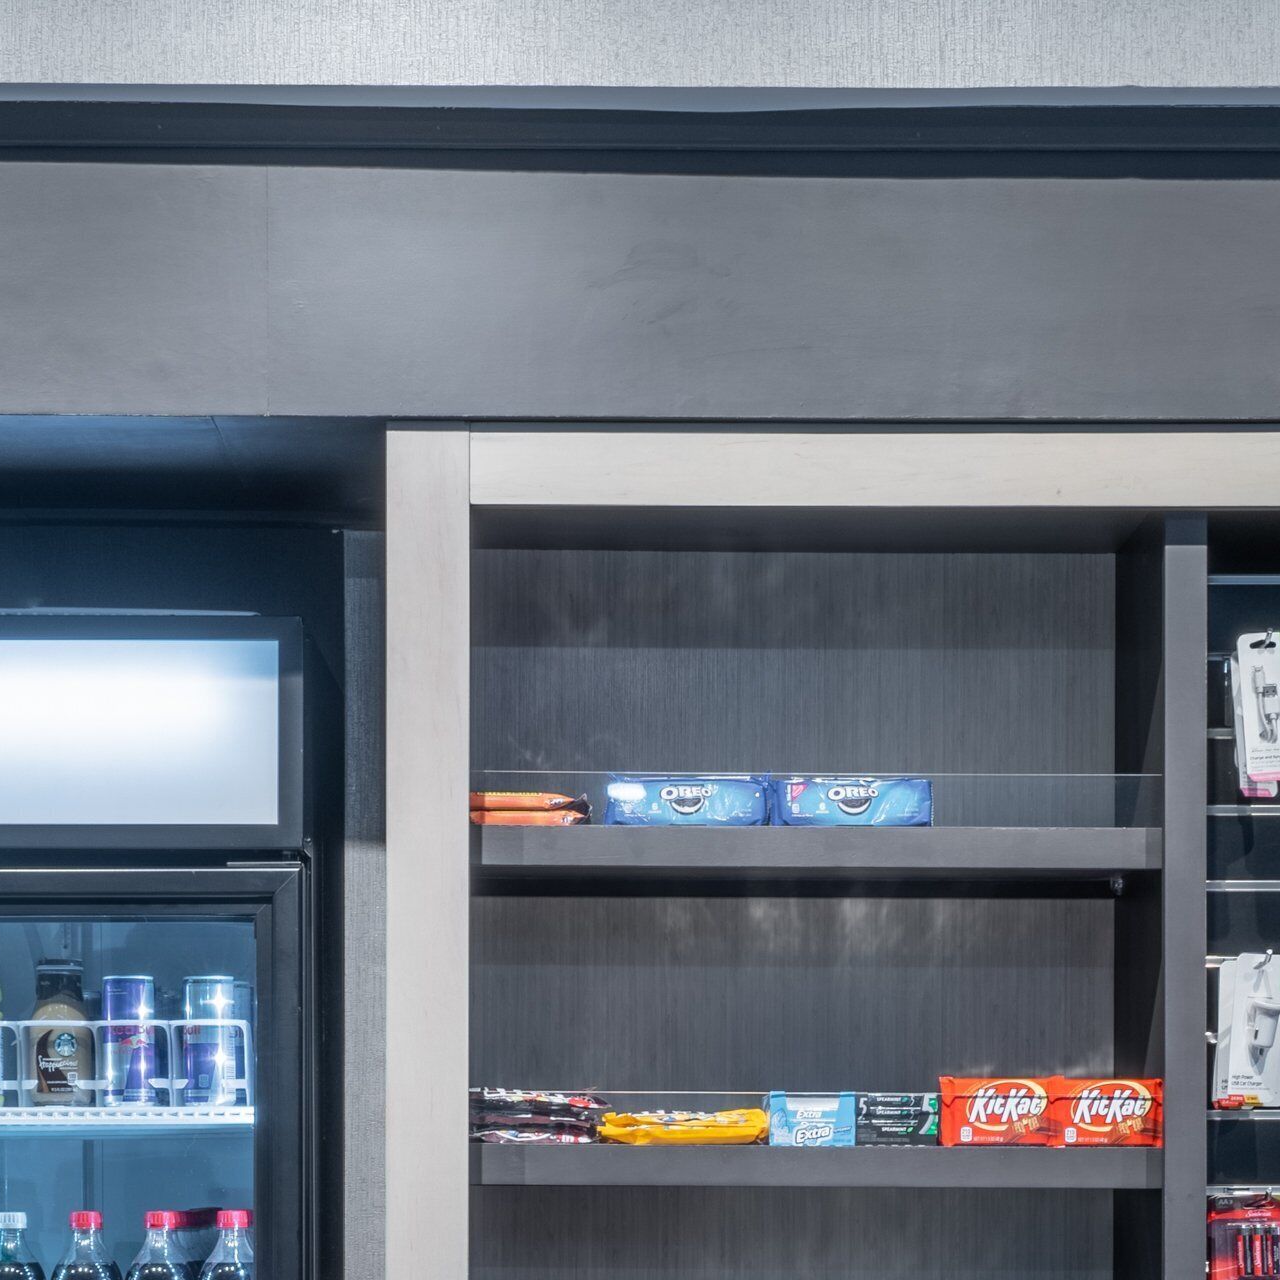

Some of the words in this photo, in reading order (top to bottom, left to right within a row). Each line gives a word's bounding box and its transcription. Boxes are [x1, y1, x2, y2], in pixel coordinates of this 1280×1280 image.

[659, 786, 713, 800] OREO
[827, 785, 879, 800] OREO
[796, 1110, 822, 1119] Extra
[795, 1126, 832, 1143] Extra
